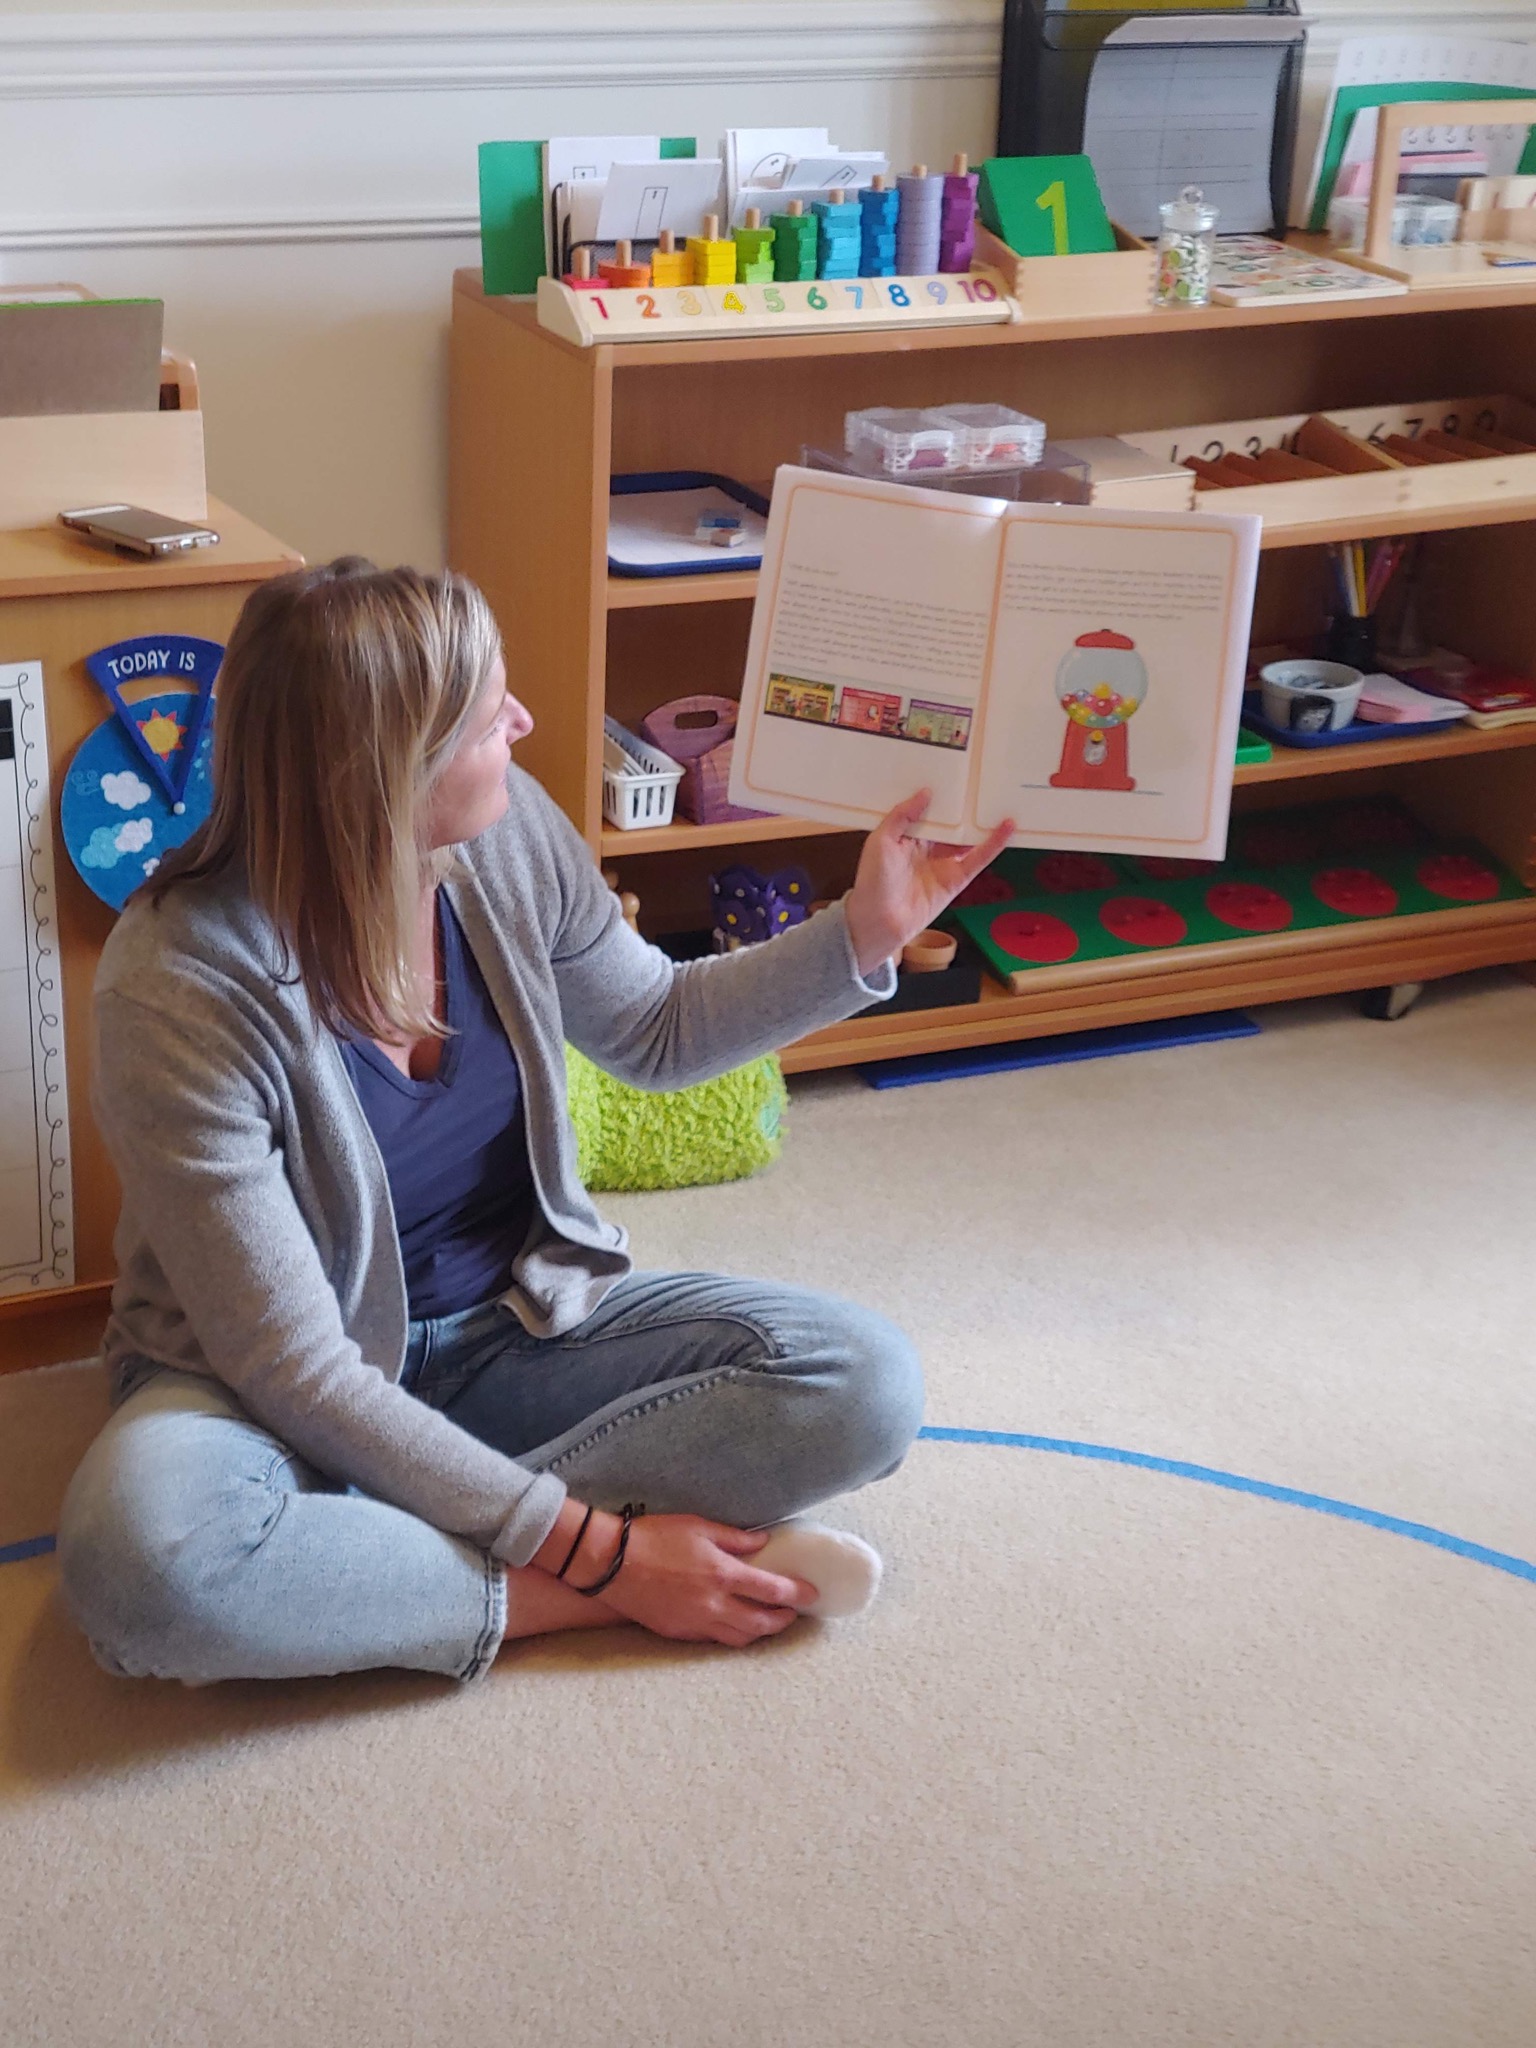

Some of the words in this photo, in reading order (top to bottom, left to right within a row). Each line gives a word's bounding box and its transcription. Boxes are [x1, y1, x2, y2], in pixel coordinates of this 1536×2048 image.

[1036, 181, 1068, 255] 1
[590, 296, 609, 320] 1
[636, 294, 661, 319] 2
[676, 290, 702, 315] 3
[722, 291, 747, 315] 4
[763, 288, 786, 313] 5
[807, 286, 828, 310] 6
[845, 286, 863, 309] 7
[888, 284, 911, 307] 8
[927, 281, 948, 305] 9
[957, 278, 998, 303] 10
[107, 649, 171, 679] TODAY
[178, 651, 196, 671] IS
